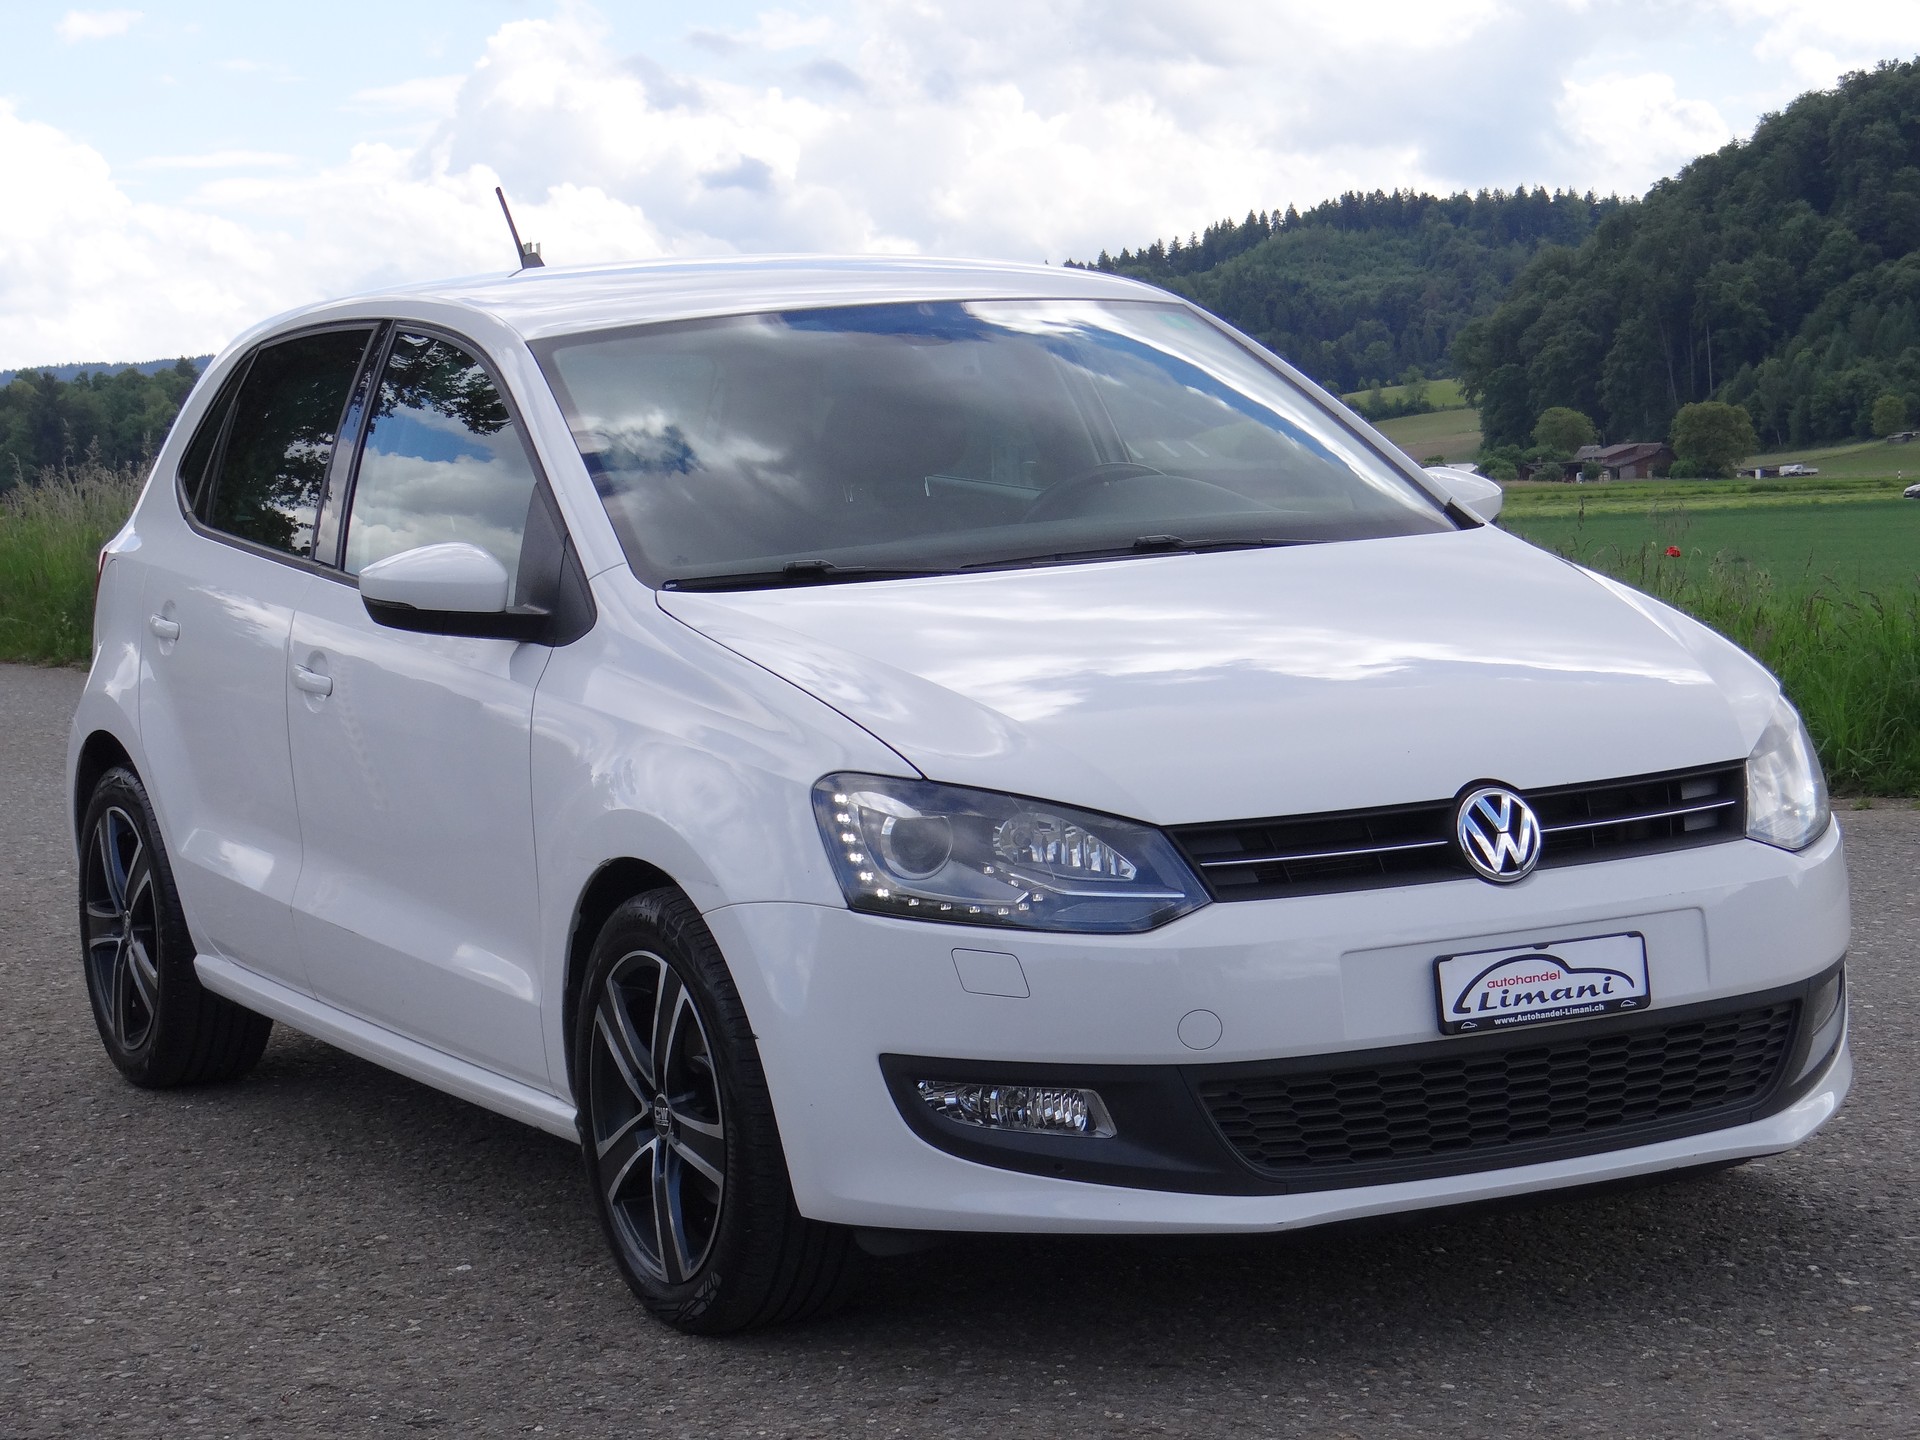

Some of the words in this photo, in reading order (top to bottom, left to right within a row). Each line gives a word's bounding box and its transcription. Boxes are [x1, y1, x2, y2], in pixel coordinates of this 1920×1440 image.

[1486, 970, 1561, 988] autohandel
[1478, 976, 1614, 1011] Limani
[1494, 1003, 1605, 1025] www.Autohandel-Limani.ch
